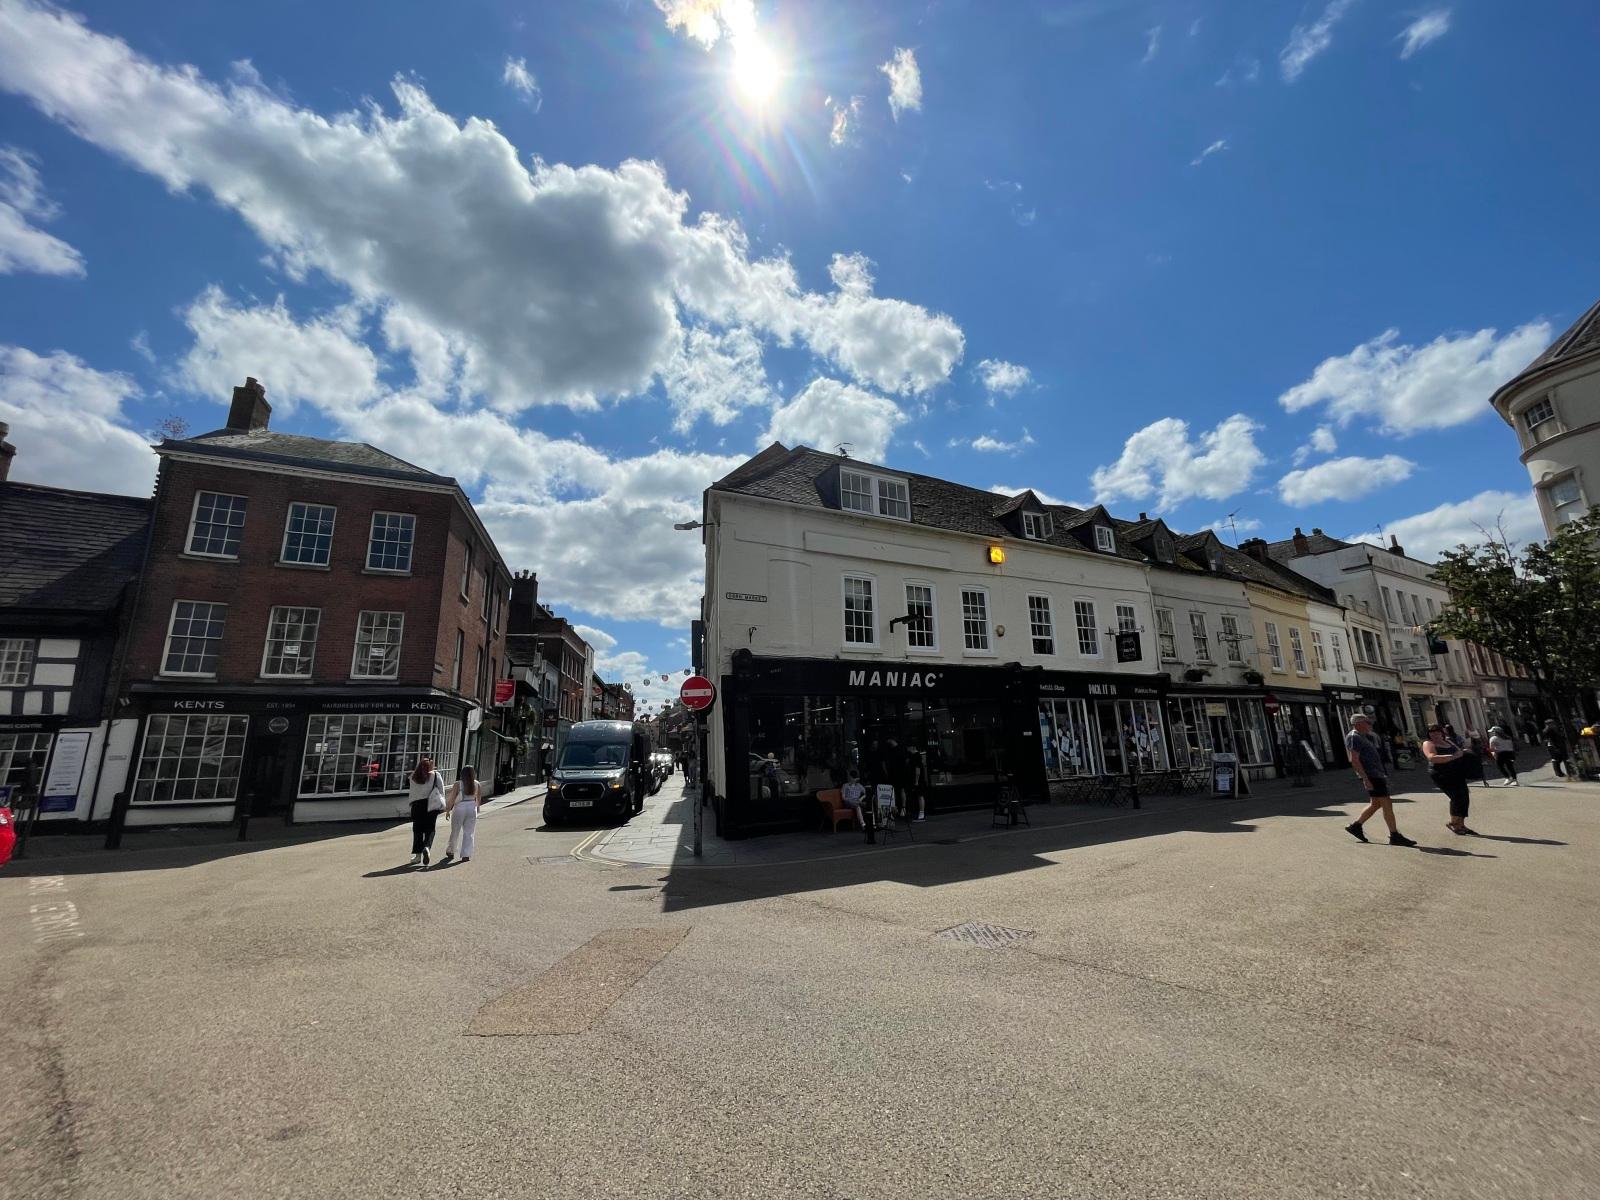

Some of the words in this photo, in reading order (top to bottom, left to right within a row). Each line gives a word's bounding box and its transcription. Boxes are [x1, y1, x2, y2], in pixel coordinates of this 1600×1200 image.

[848, 669, 936, 688] MANIAC
[174, 700, 225, 709] KENTS
[411, 702, 441, 710] KENTS
